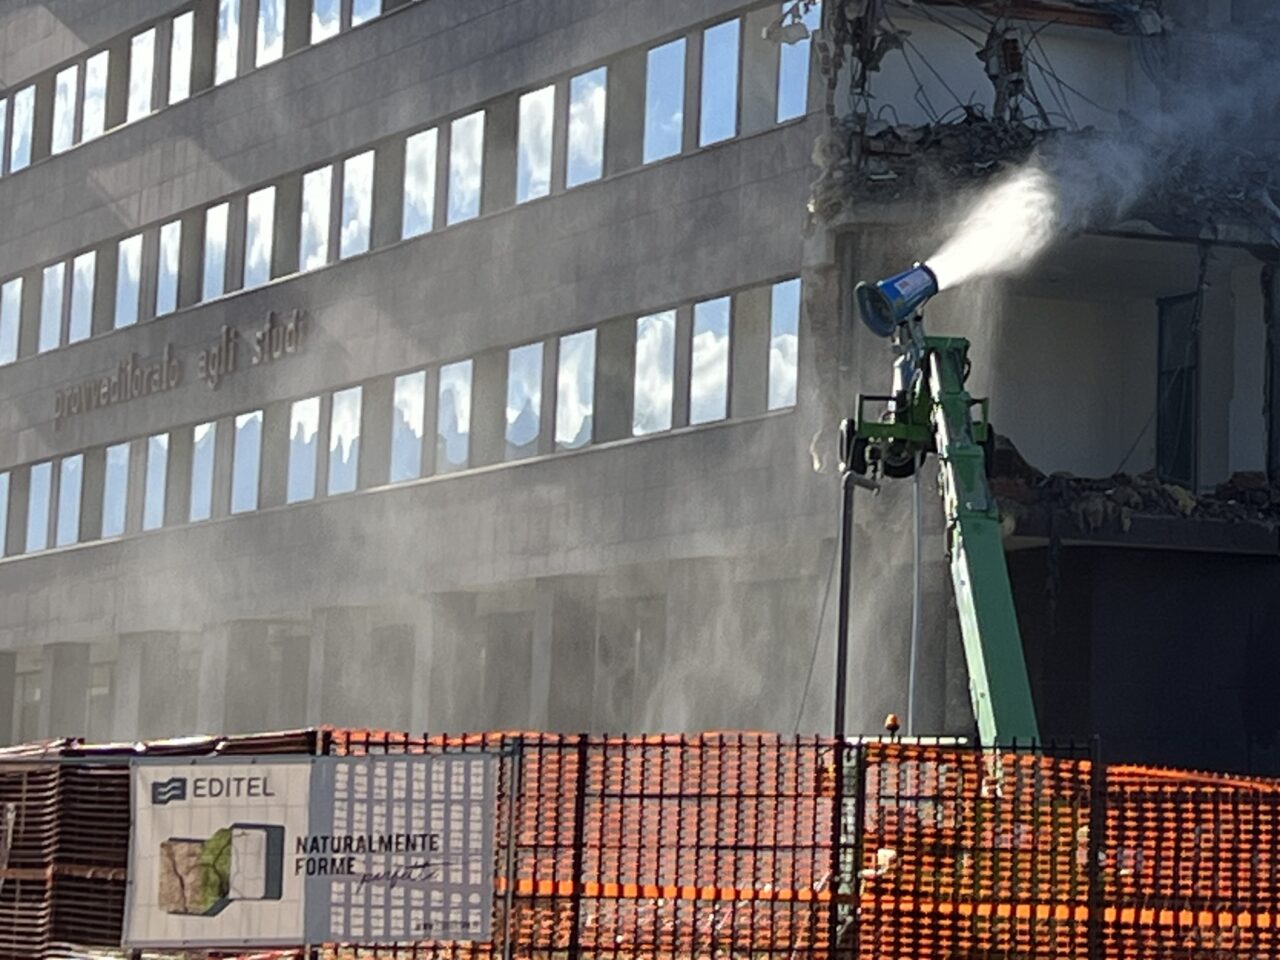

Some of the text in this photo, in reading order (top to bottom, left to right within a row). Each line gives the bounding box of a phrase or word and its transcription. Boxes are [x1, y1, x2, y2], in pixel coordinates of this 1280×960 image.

[198, 325, 239, 389] agli
[193, 777, 275, 797] EDITEL
[296, 833, 440, 855] NATURALMENTE
[295, 857, 357, 877] FORME
